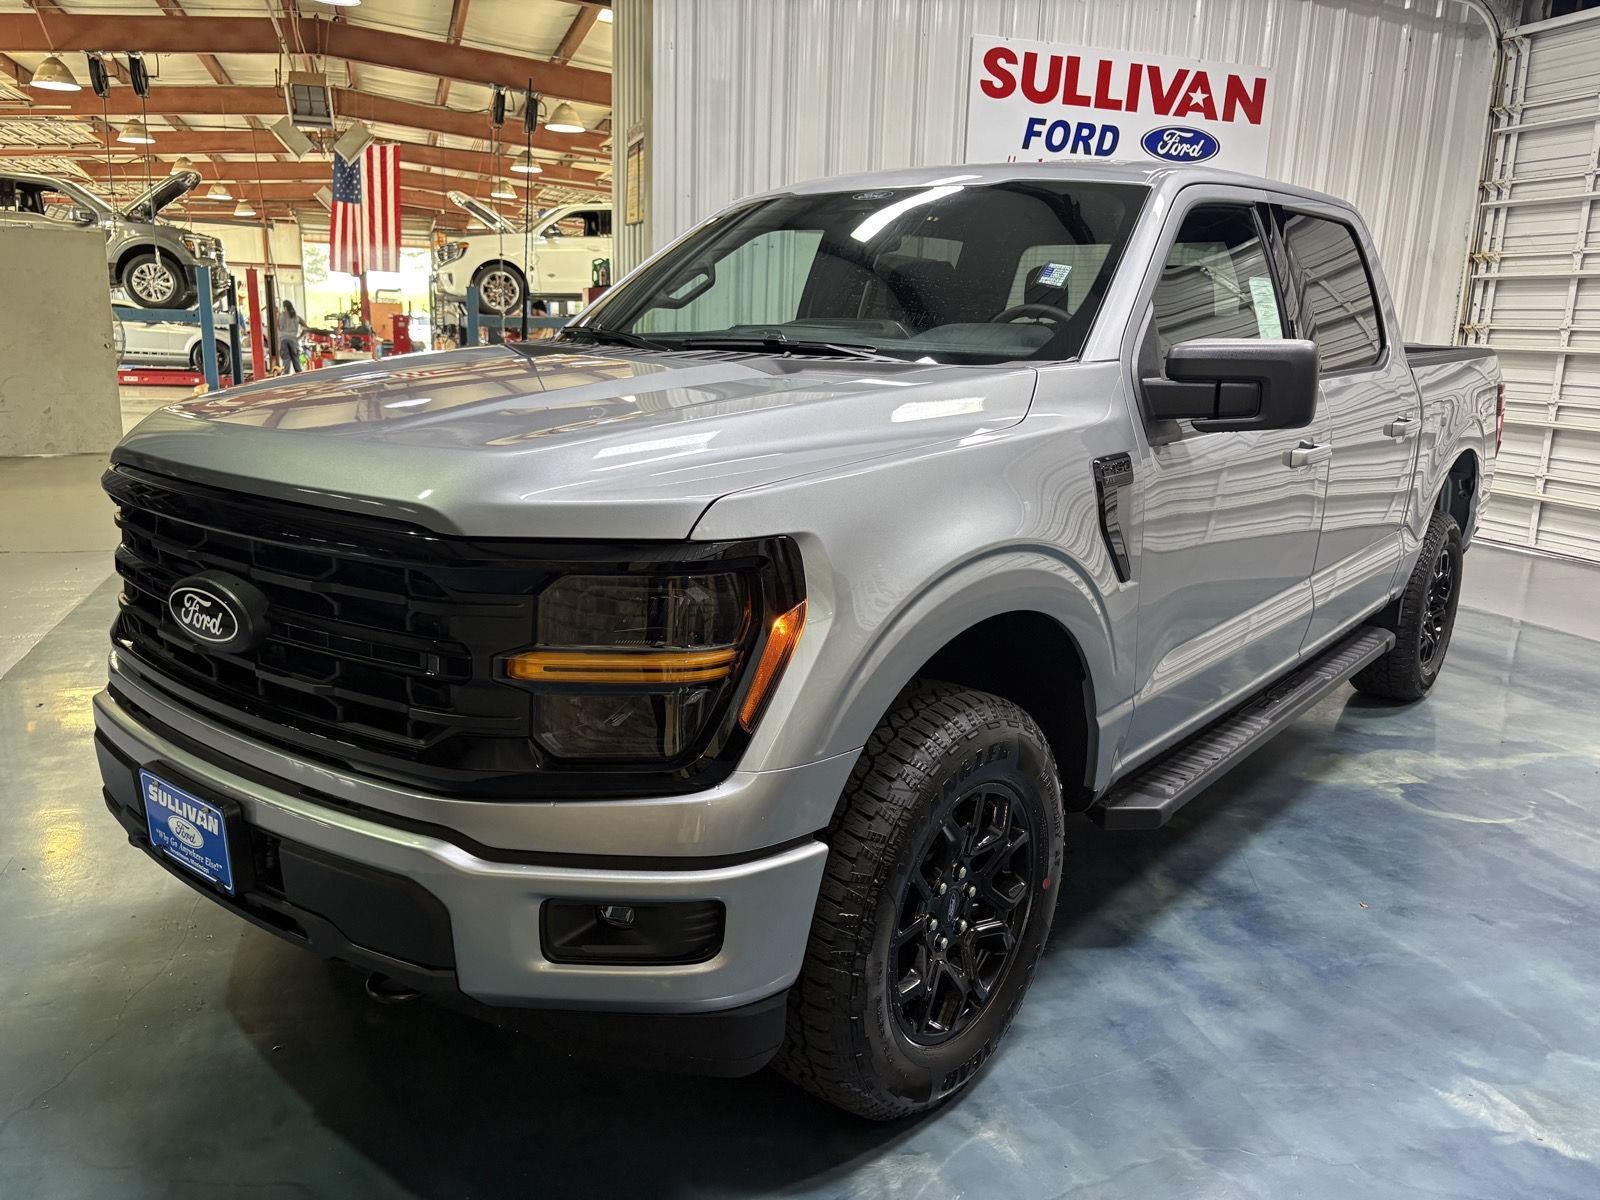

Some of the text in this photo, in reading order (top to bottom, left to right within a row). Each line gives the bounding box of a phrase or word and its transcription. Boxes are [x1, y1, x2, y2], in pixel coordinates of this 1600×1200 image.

[980, 46, 1267, 125] SULLIVAN
[1021, 117, 1120, 157] FORD
[1157, 129, 1204, 157] Ford
[181, 593, 223, 635] Ford
[148, 783, 219, 836] SULLIVAN
[170, 836, 178, 848] Go
[179, 842, 204, 863] Anywhere
[175, 820, 197, 844] Ford
